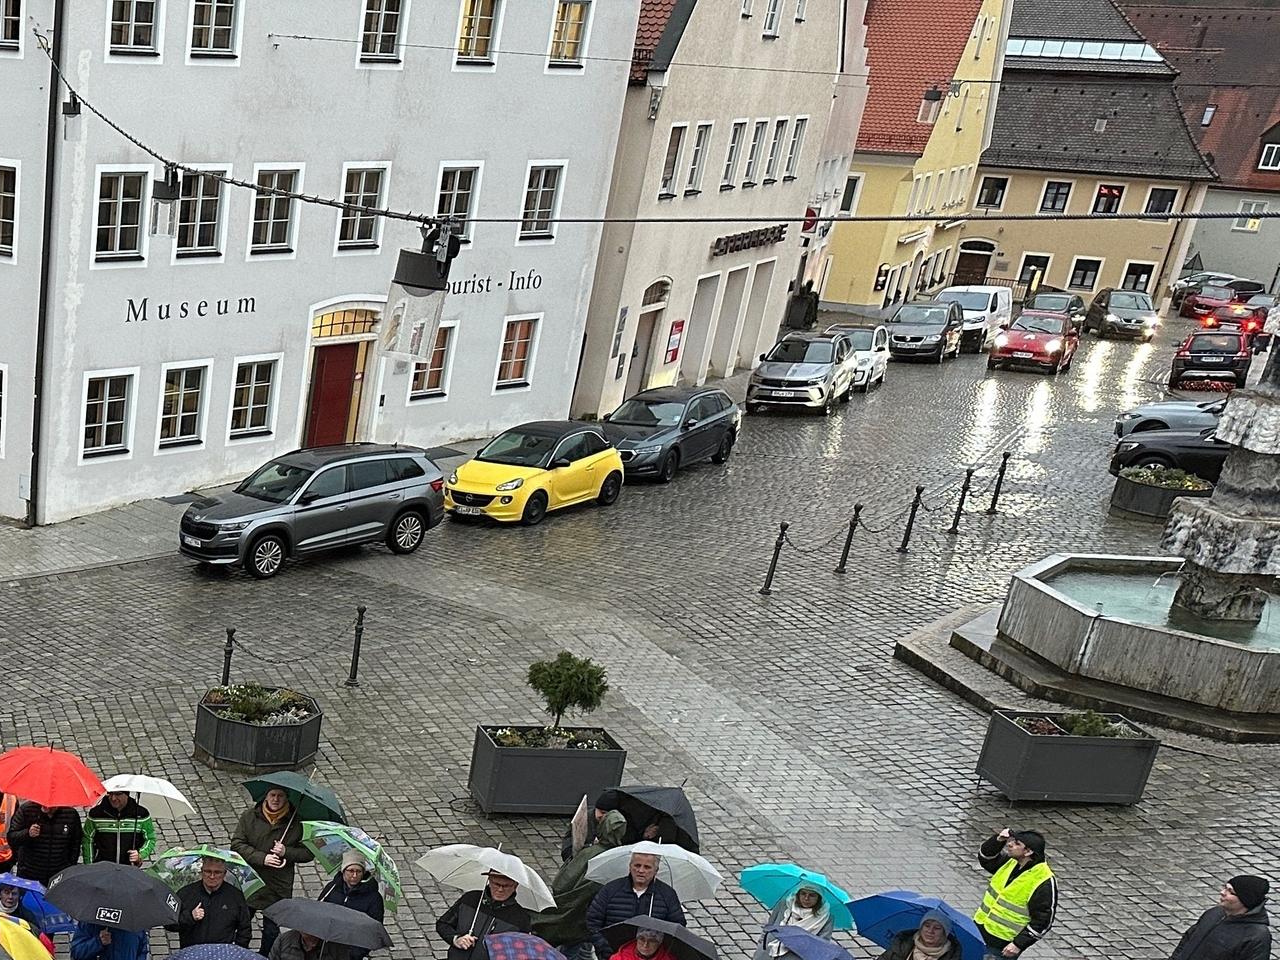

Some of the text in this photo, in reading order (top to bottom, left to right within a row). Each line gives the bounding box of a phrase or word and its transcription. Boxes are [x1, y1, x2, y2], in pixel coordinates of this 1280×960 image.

[445, 274, 492, 295] ourist
[508, 269, 542, 291] Info
[125, 297, 256, 323] Museum
[100, 909, 119, 920] F&C
